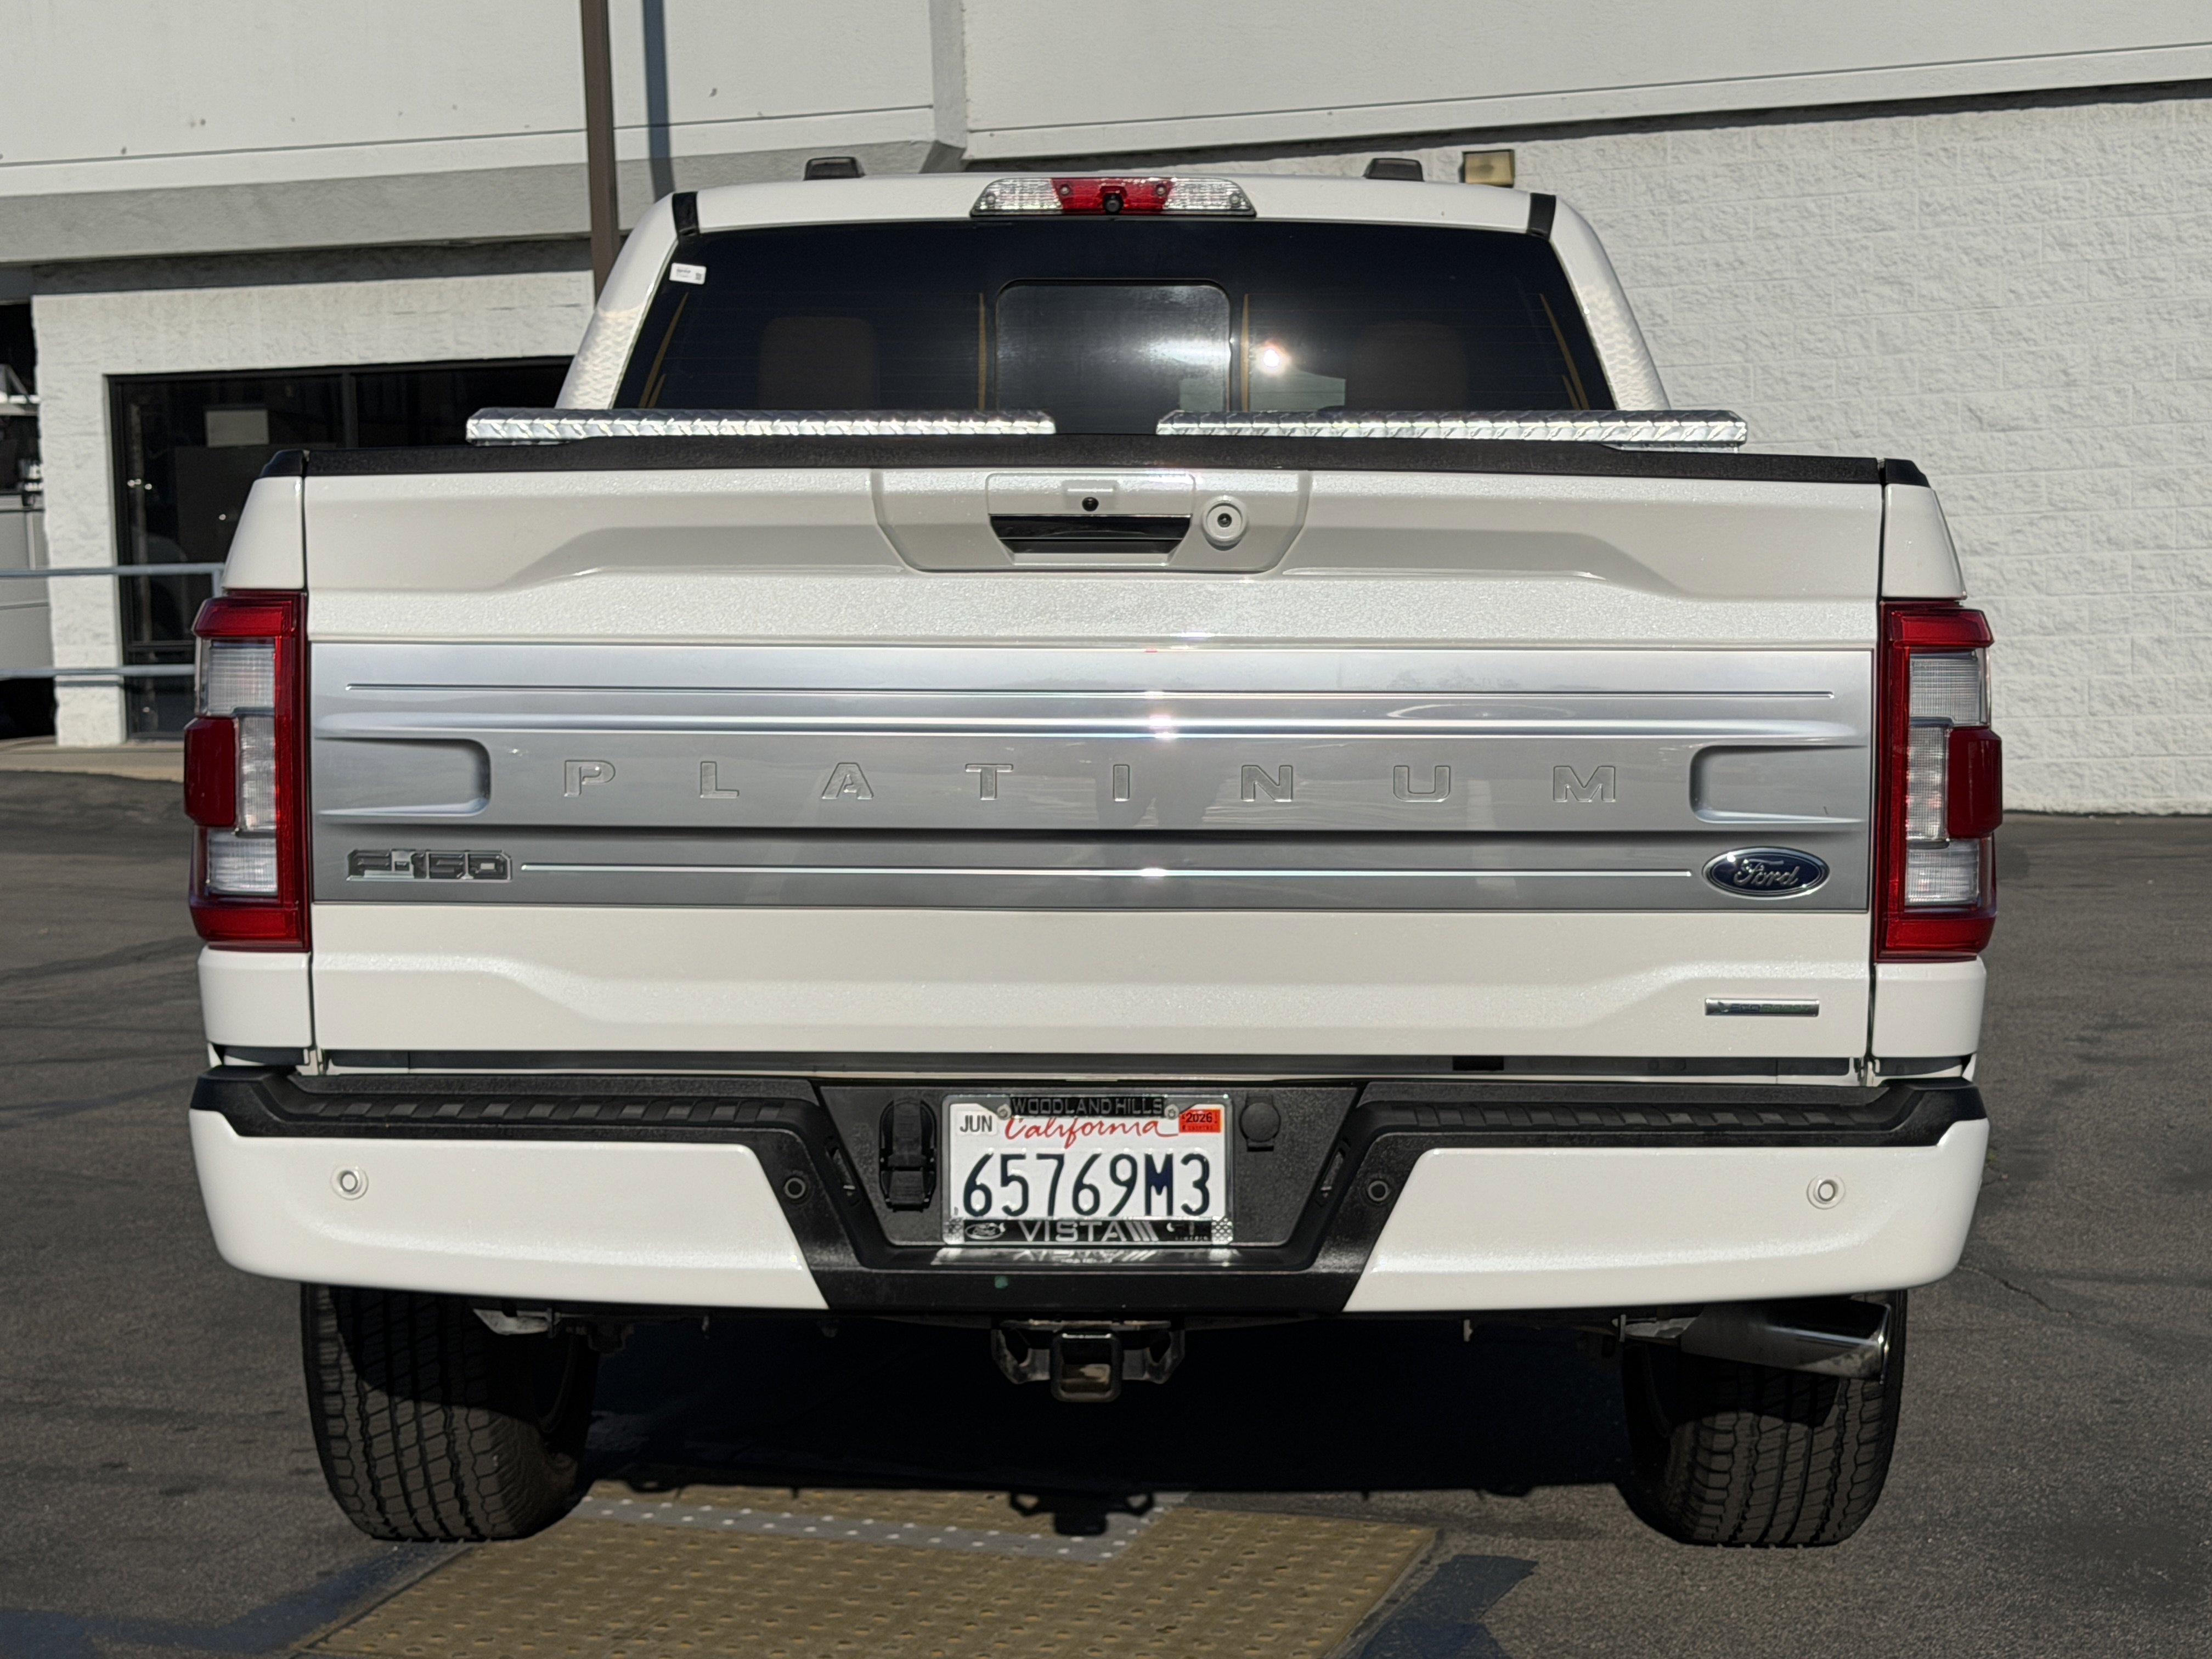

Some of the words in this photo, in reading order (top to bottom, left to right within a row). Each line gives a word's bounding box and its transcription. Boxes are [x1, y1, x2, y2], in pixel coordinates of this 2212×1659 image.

[563, 759, 1617, 803] PLATINUM
[1733, 859, 1800, 887] Ford
[1012, 1098, 1111, 1114] WOODLAND
[1115, 1098, 1162, 1114] HILLS
[1186, 1111, 1213, 1123] 2026
[960, 1115, 992, 1132] JUN
[1005, 1116, 1178, 1149] California
[963, 1153, 1210, 1217] 65769M3
[1018, 1221, 1127, 1242] VISTA
